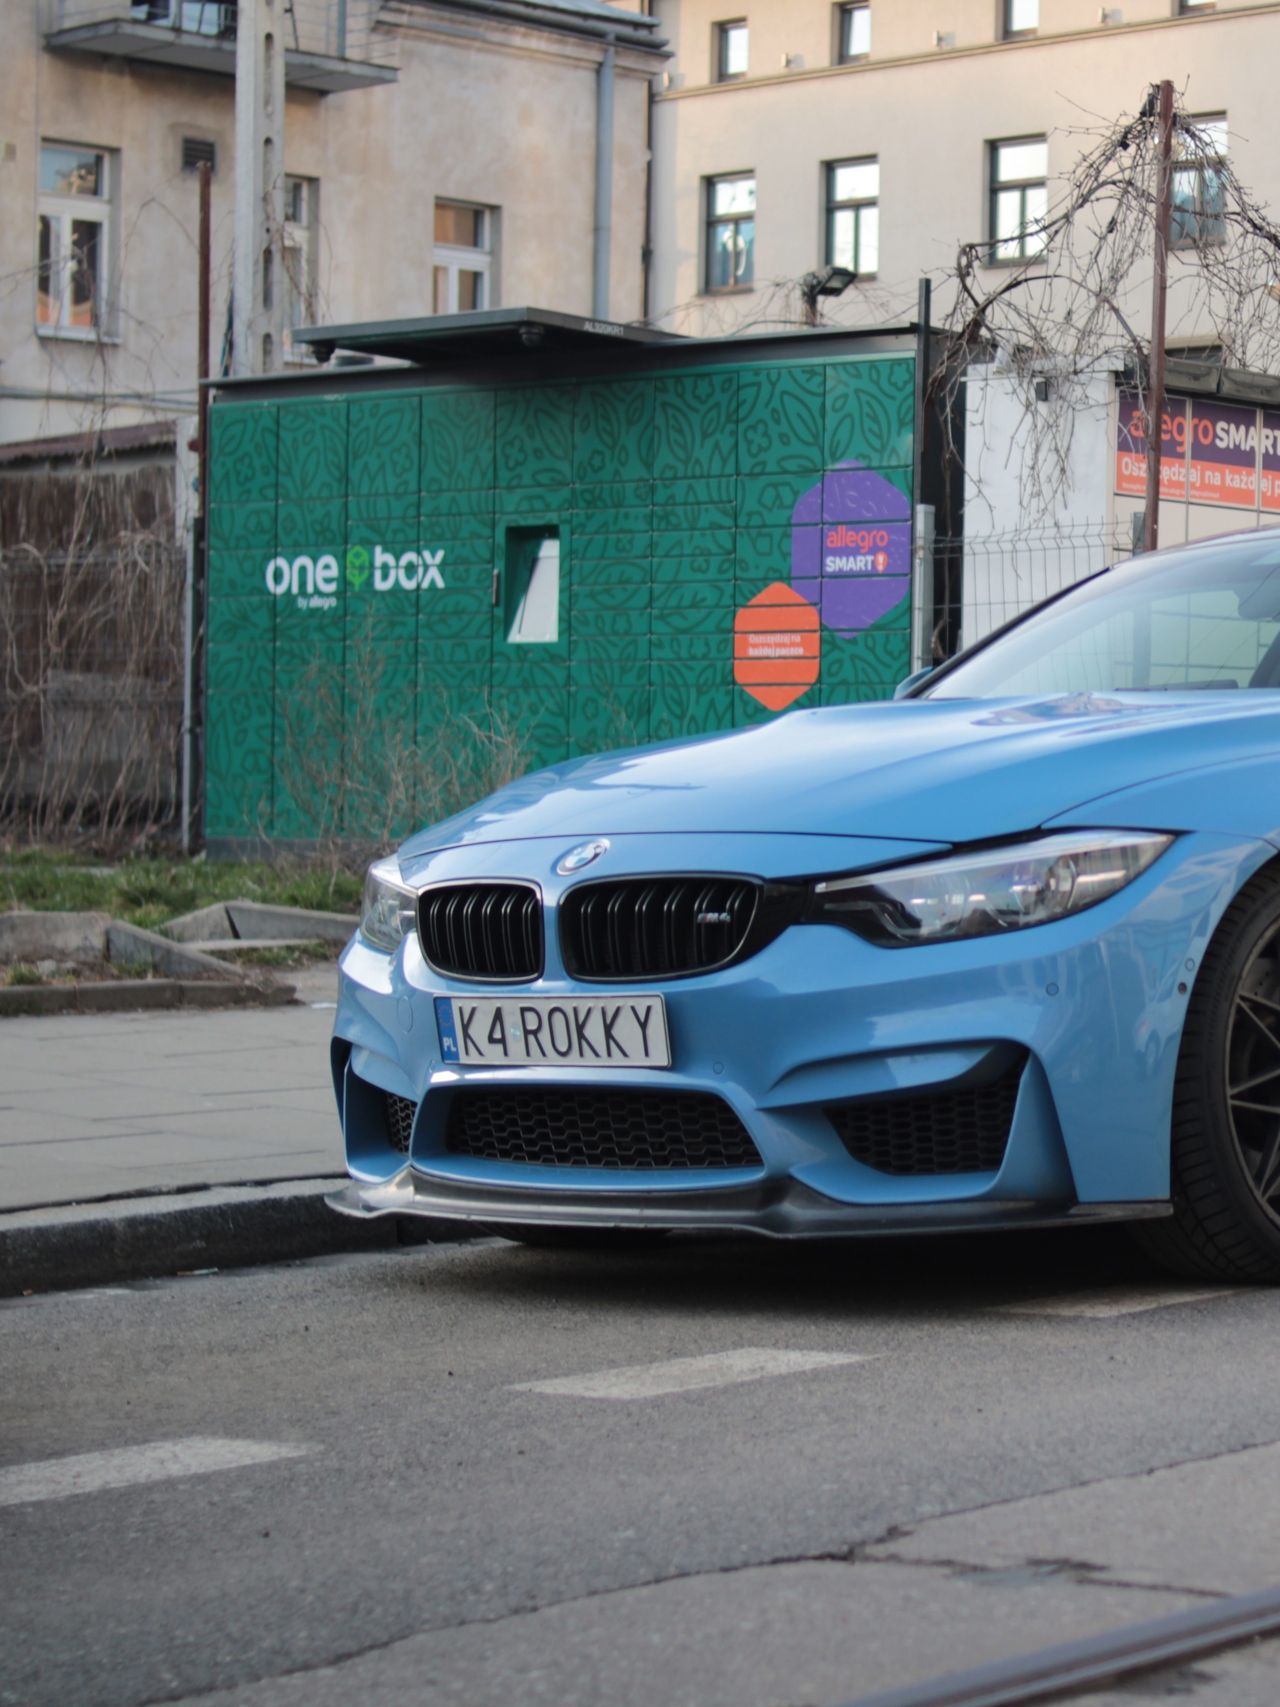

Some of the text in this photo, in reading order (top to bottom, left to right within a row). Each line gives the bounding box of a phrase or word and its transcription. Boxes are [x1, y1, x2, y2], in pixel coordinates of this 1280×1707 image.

[1130, 410, 1214, 453] aegro
[1121, 456, 1201, 487] Oszędzaj
[1205, 469, 1222, 487] na
[1225, 469, 1273, 497] każdej
[826, 524, 889, 554] allegro
[265, 545, 446, 595] one box
[308, 594, 337, 611] allegro
[791, 634, 801, 643] na
[442, 1036, 457, 1052] PL
[458, 1005, 653, 1058] K4 ROKKY
